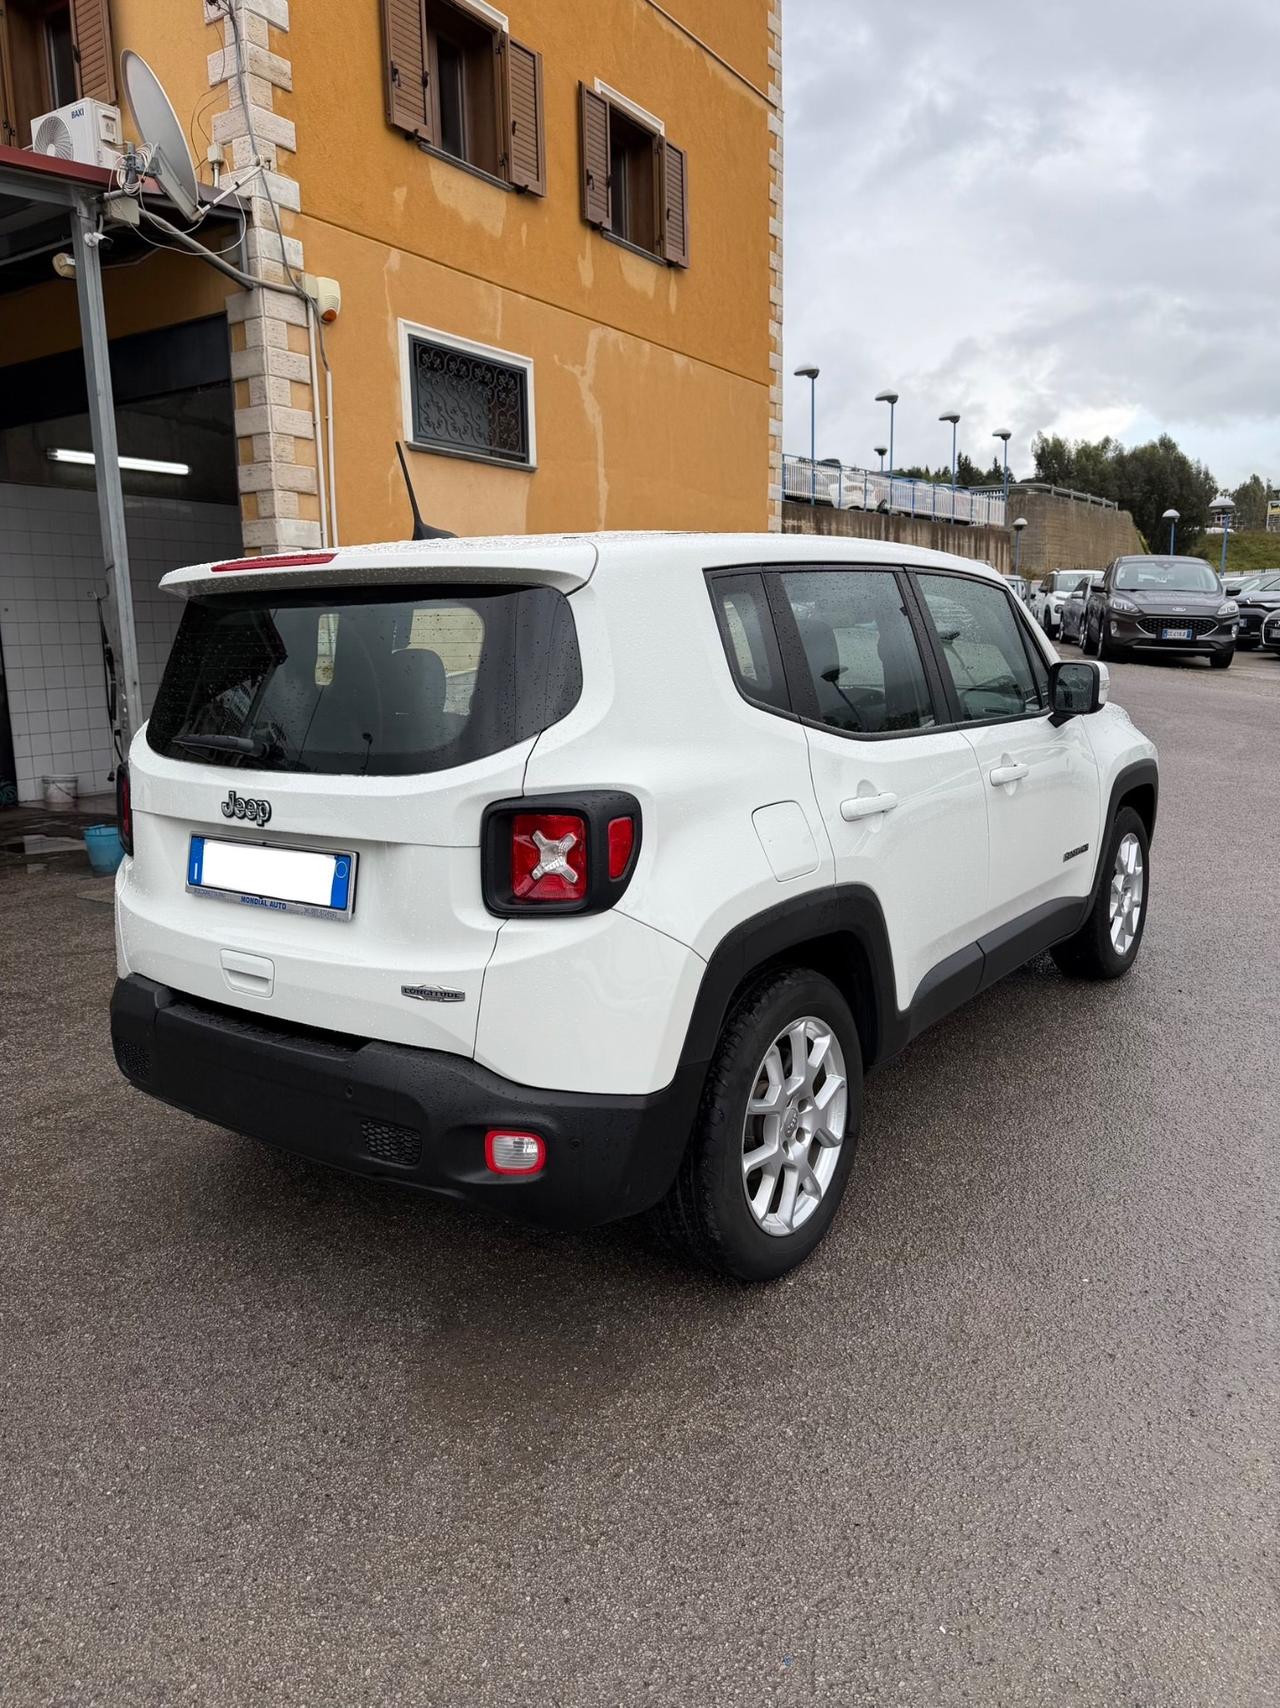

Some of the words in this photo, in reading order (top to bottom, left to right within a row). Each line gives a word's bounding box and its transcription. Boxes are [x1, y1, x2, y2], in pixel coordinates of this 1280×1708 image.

[71, 108, 84, 119] BAXI
[221, 790, 272, 827] Jeep
[240, 896, 268, 908] MONDIAL
[269, 900, 287, 910] AUTO
